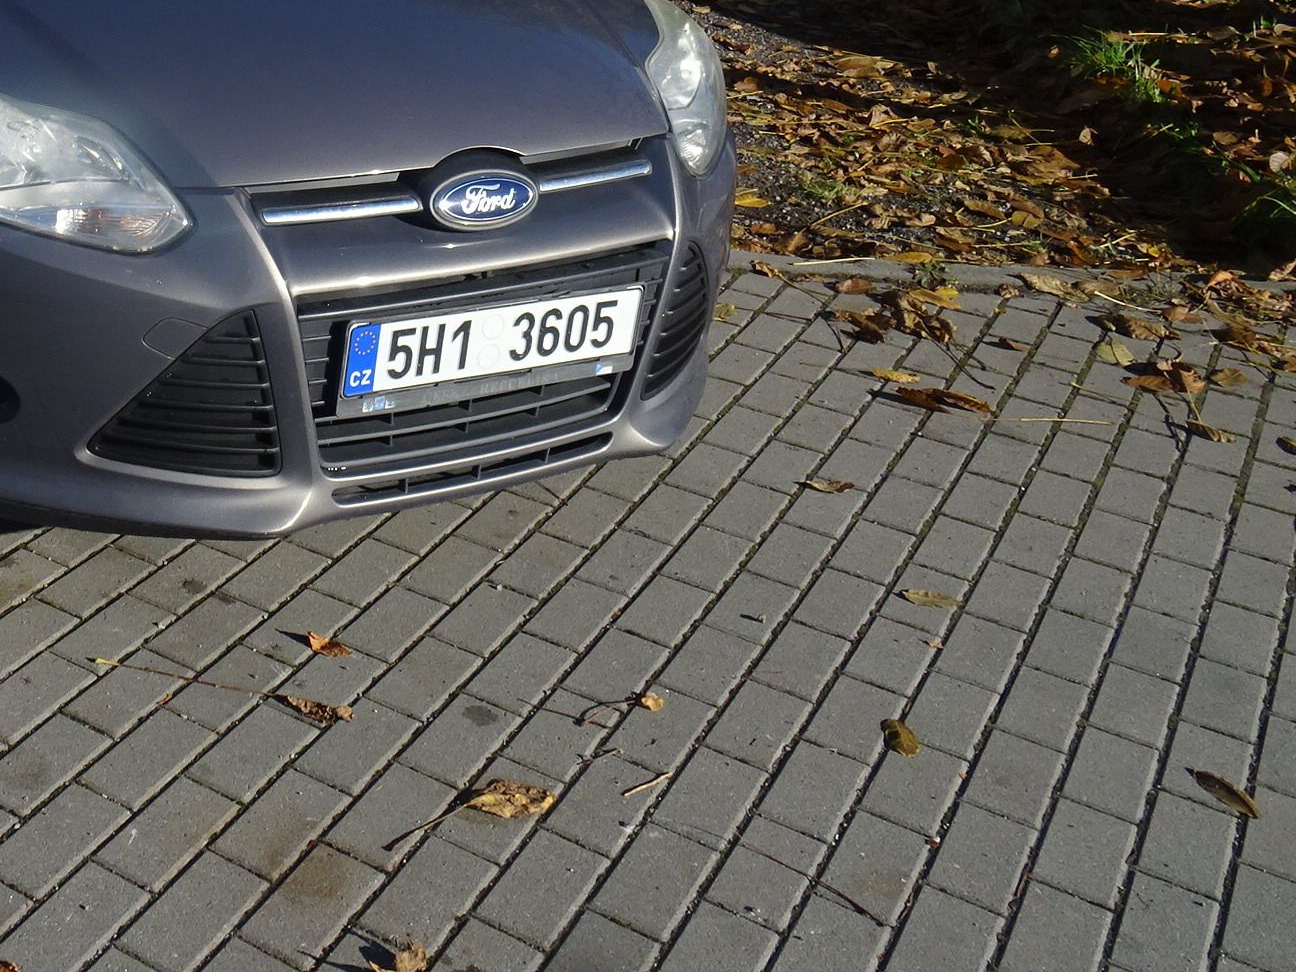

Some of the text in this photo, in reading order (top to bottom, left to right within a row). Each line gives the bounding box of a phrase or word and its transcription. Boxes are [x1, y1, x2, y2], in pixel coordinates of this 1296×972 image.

[460, 183, 517, 215] Ford
[387, 299, 619, 380] 5H1 3605
[349, 370, 372, 389] CZ
